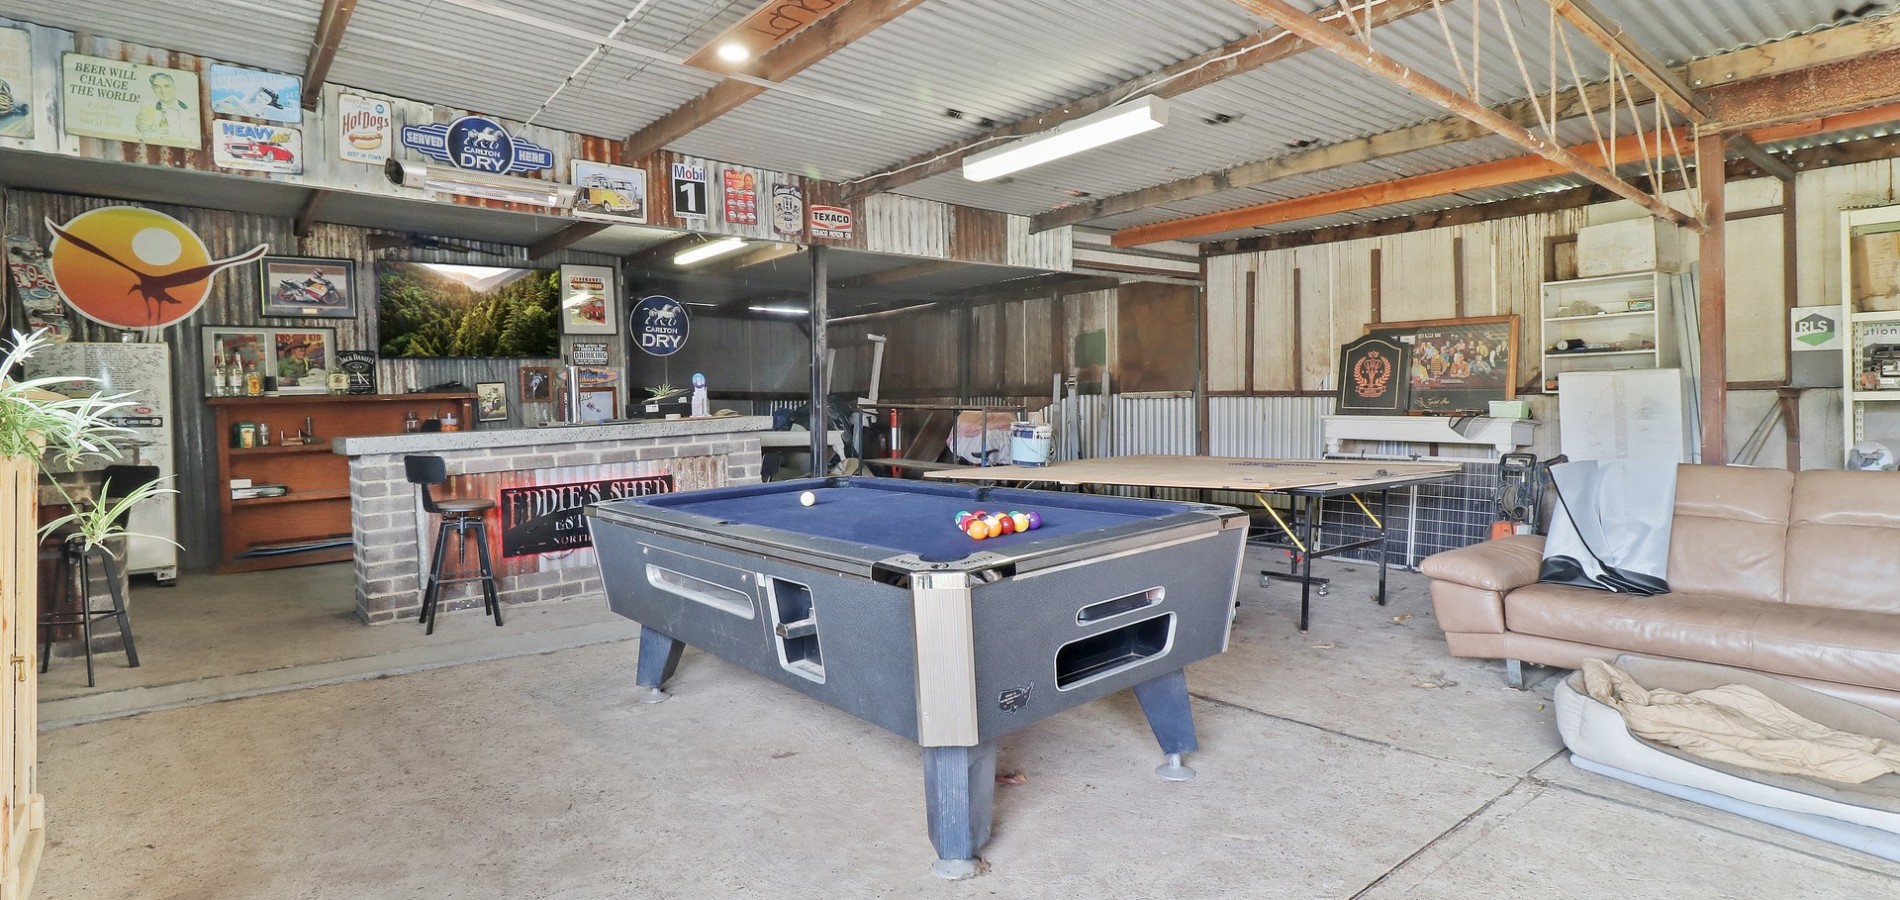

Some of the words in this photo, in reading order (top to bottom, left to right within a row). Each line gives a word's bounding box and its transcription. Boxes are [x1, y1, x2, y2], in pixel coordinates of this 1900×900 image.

[75, 62, 106, 75] BEER
[109, 67, 137, 80] WILL
[79, 74, 129, 90] CHANGE
[70, 84, 94, 96] THE
[97, 88, 141, 103] WORLD!
[222, 123, 274, 141] HEAVY
[342, 110, 361, 137] Hot
[362, 112, 389, 131] Dogs
[406, 131, 444, 148] SERVED
[463, 146, 501, 157] CARLTON
[518, 150, 545, 164] HERE
[460, 152, 505, 171] DRY
[674, 164, 706, 181] Mobil
[680, 182, 696, 212] 1
[813, 212, 849, 224] TEXACO
[645, 326, 678, 335] CARLTON
[1798, 320, 1828, 333] RLS
[641, 333, 682, 348] DRY
[574, 351, 607, 359] DRINKING
[506, 482, 601, 530] EDDIE'S
